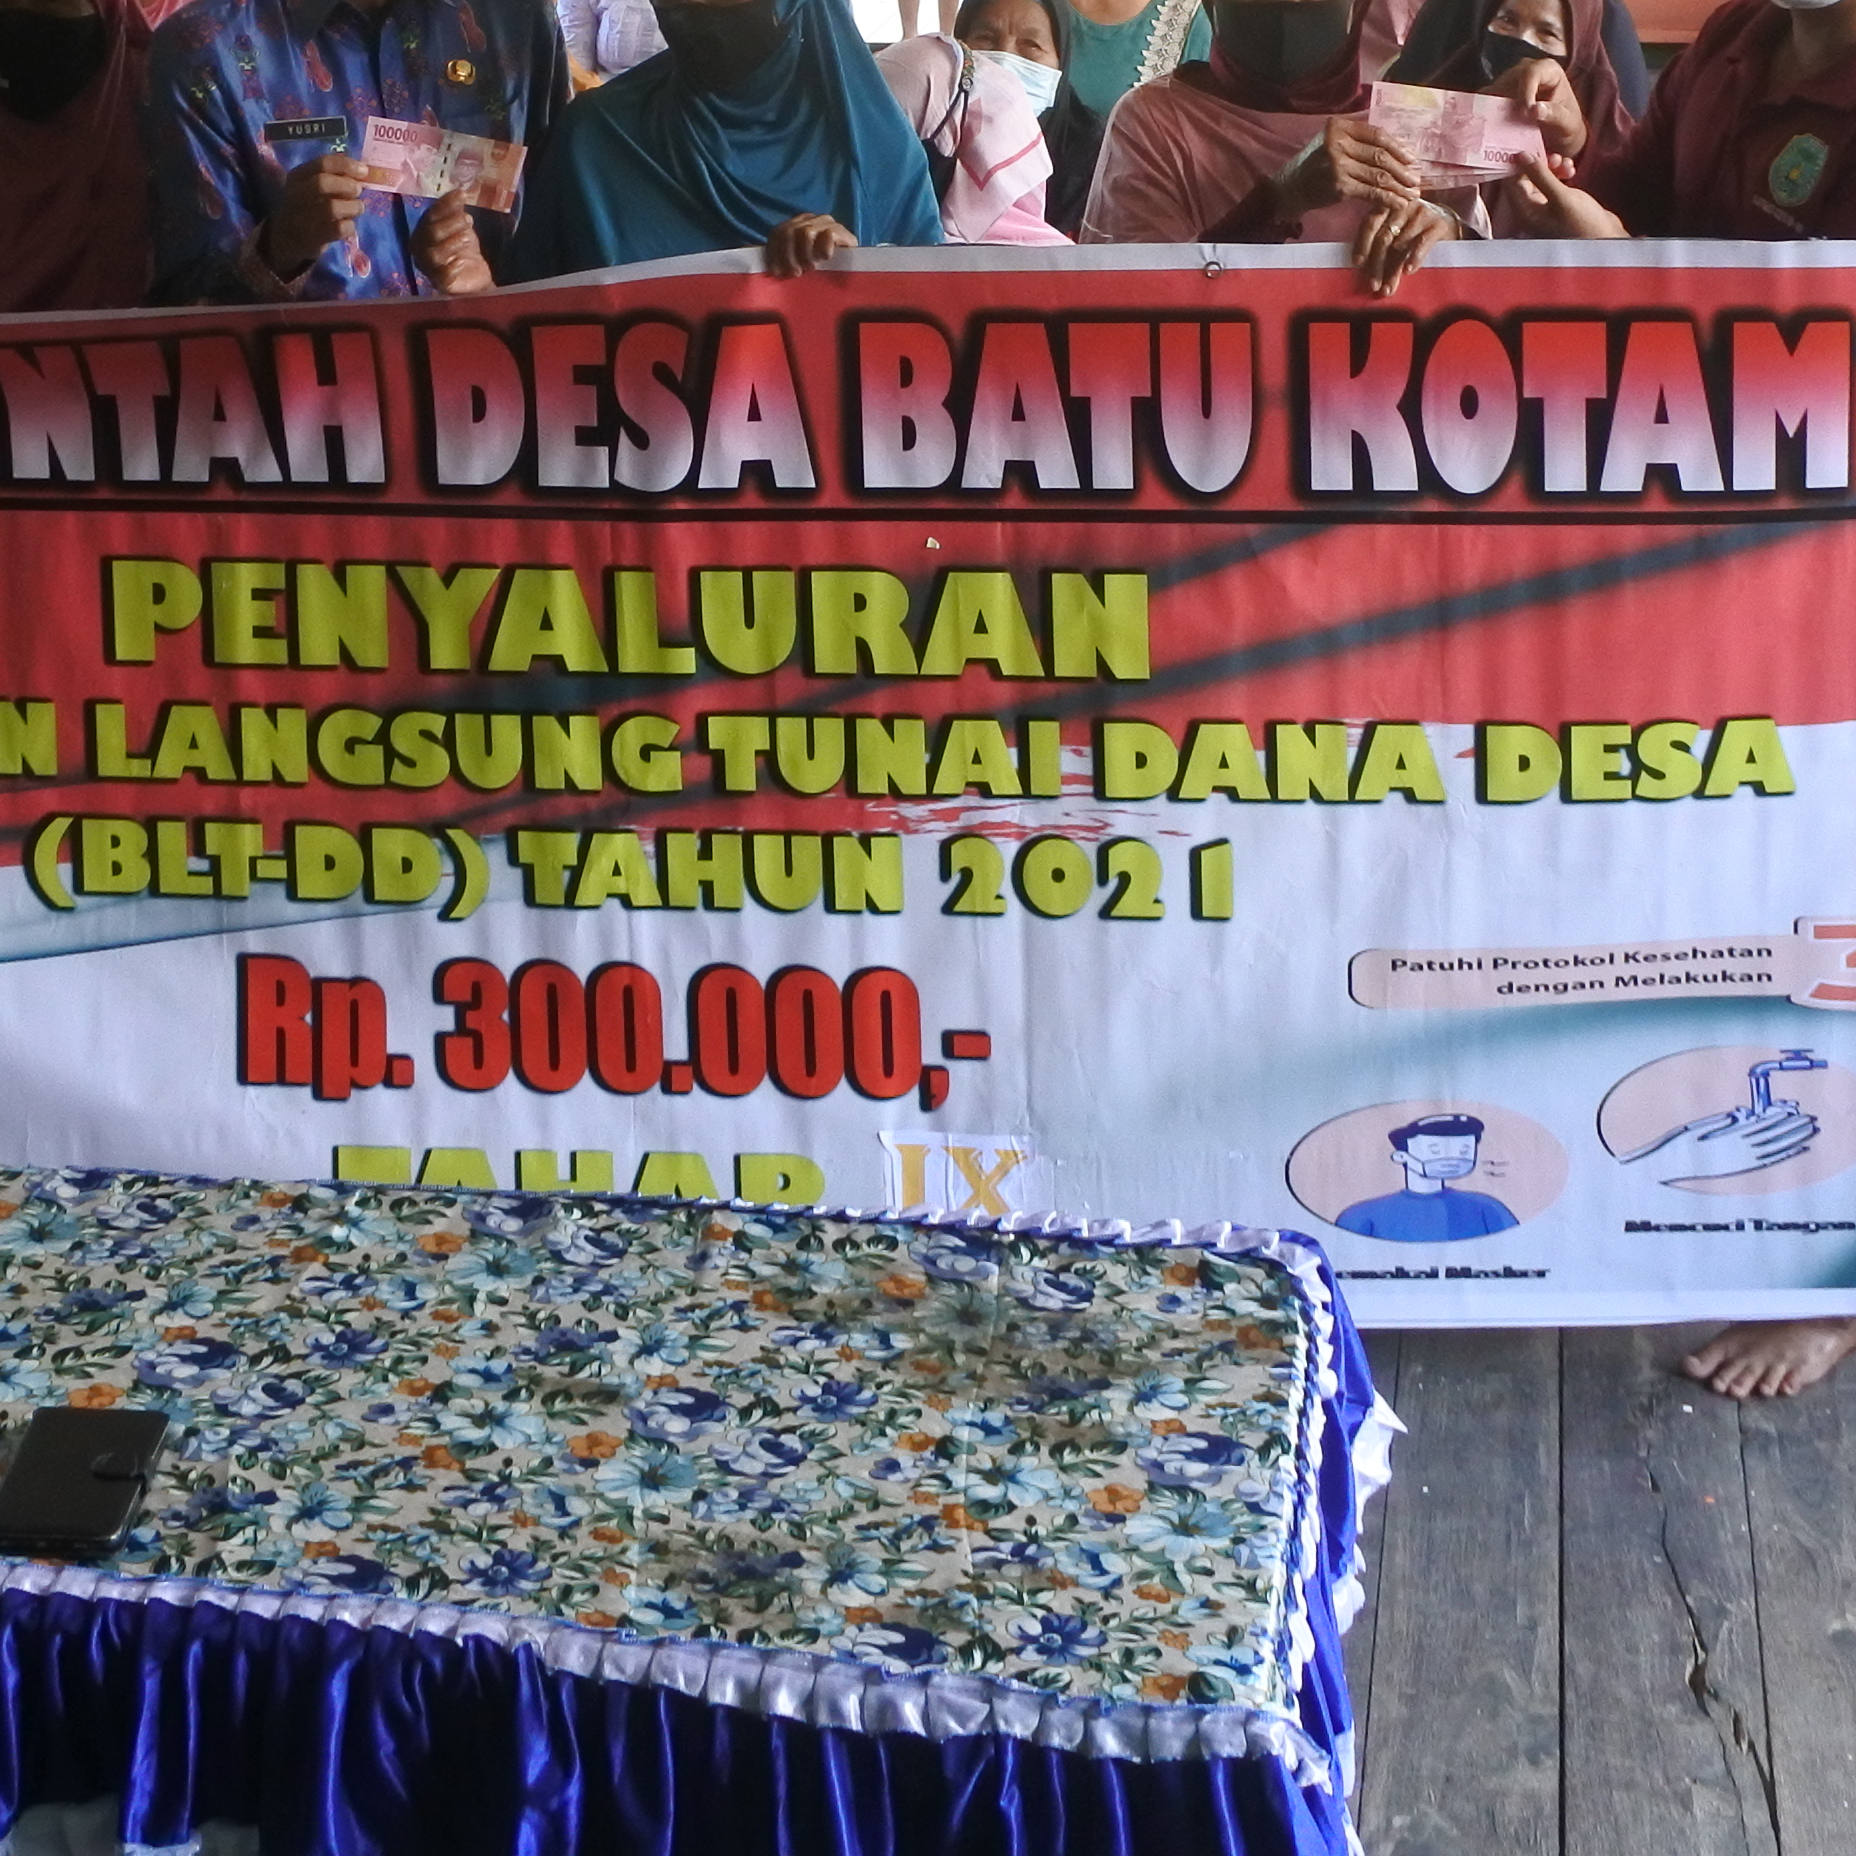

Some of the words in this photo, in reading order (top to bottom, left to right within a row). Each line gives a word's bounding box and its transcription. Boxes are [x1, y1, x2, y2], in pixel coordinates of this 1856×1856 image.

[287, 123, 327, 135] YUSRI
[372, 123, 419, 143] 100000
[425, 320, 818, 494] DESA
[857, 320, 1255, 494] BATU
[1306, 318, 1852, 495] KOTAM
[109, 559, 1151, 681] PENYALURAN
[93, 701, 684, 793] LANGSUNG
[706, 715, 1062, 797] TUNAI
[1100, 720, 1447, 802] DANA
[1482, 717, 1798, 803] DESA
[32, 816, 492, 920] (BLT-DD)
[515, 829, 905, 913] TAHUN
[943, 836, 1234, 919] 2021
[1390, 956, 1484, 973] Patuhi
[1491, 951, 1615, 972] Protokol
[1623, 945, 1773, 965] Kesehatan
[1496, 977, 1606, 997] dengan
[1613, 970, 1773, 988] Melakukan
[241, 954, 415, 1100] Rp.
[434, 958, 992, 1111] 300.000,-
[894, 1143, 1028, 1216] IX
